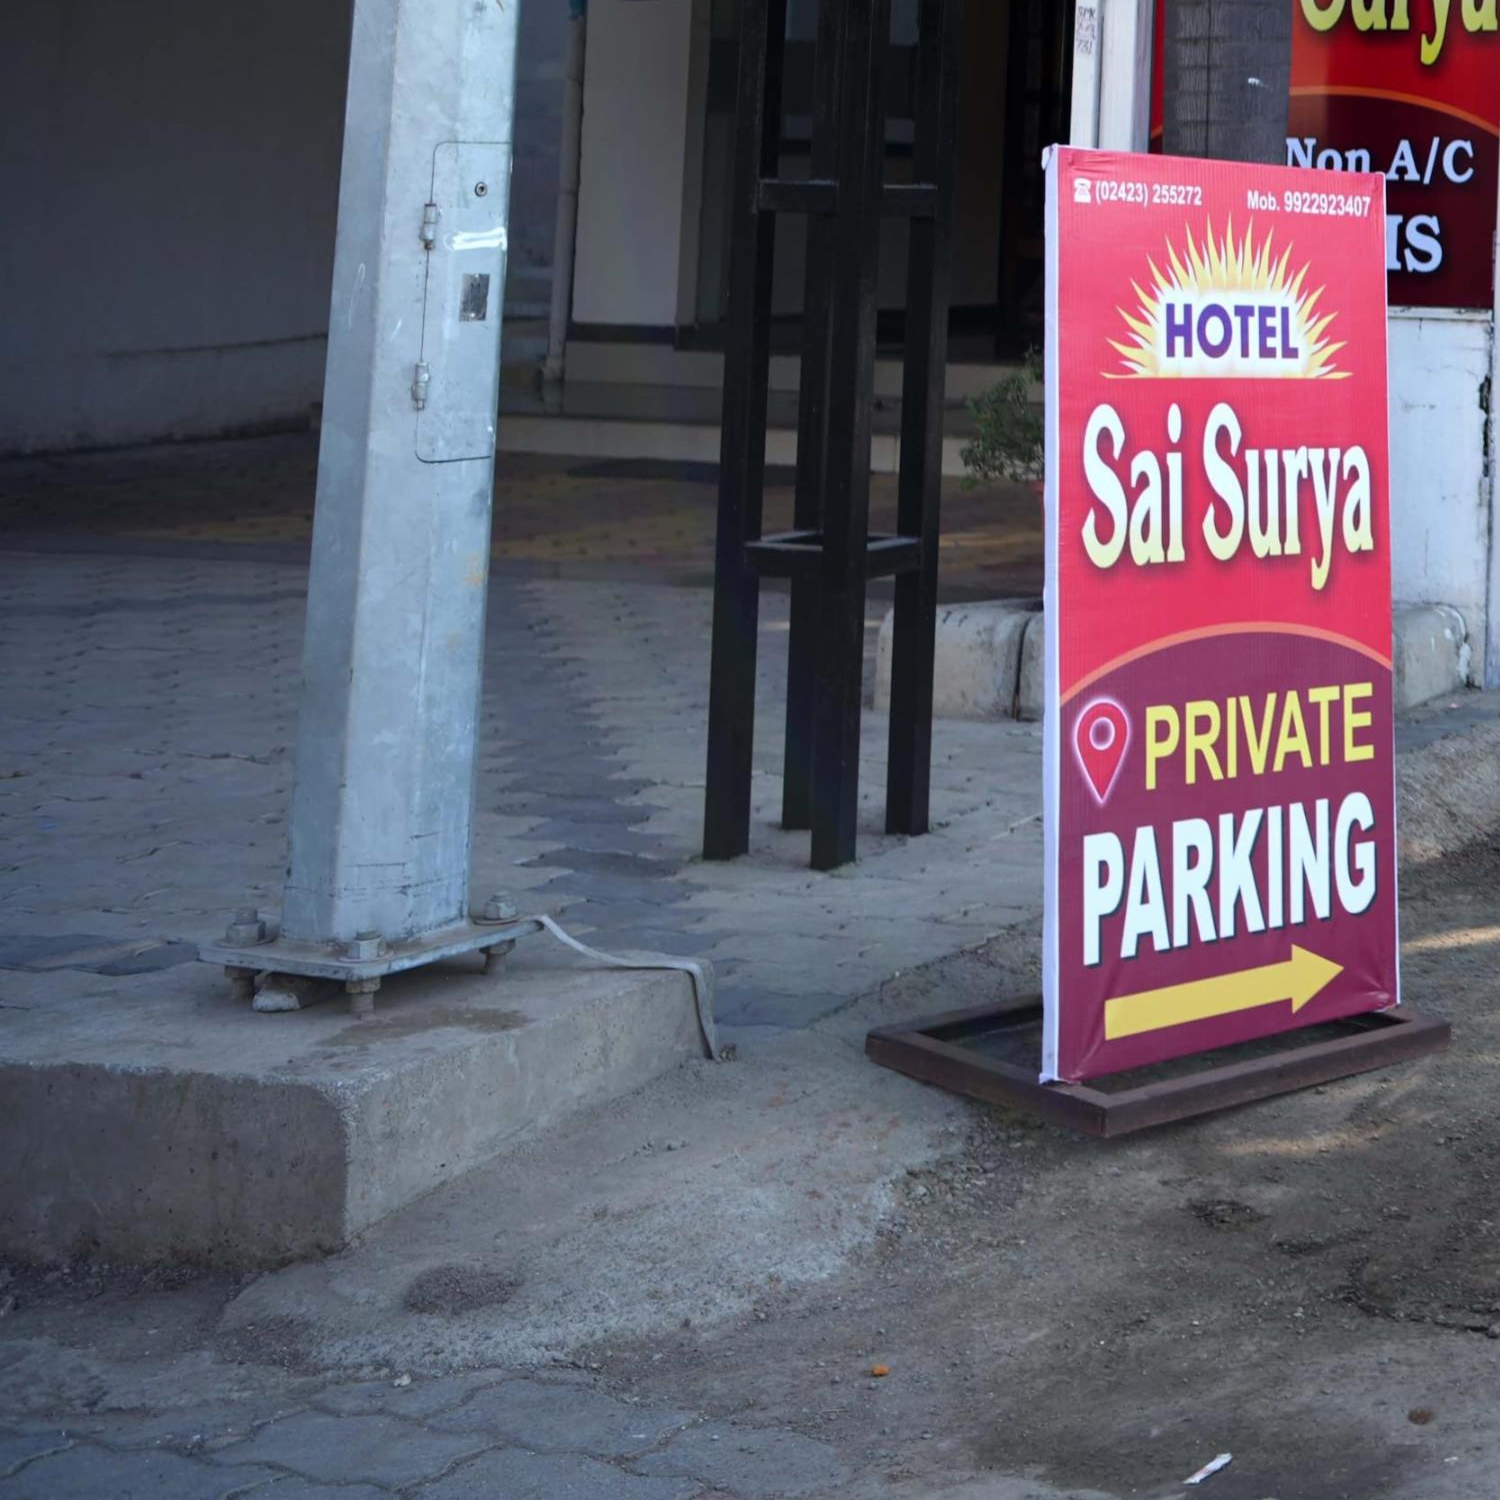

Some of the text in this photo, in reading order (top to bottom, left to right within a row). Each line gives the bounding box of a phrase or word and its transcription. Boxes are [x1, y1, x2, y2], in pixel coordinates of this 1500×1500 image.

[1286, 136, 1475, 185] Non A/C
[1095, 179, 1202, 207] (02423) 255272
[1247, 190, 1371, 217] Mob. 9922923407
[1165, 303, 1299, 359] HOTEL
[1081, 402, 1374, 591] Sai Surya
[1145, 682, 1375, 790] PRIVATE
[1083, 791, 1377, 966] PARKING
